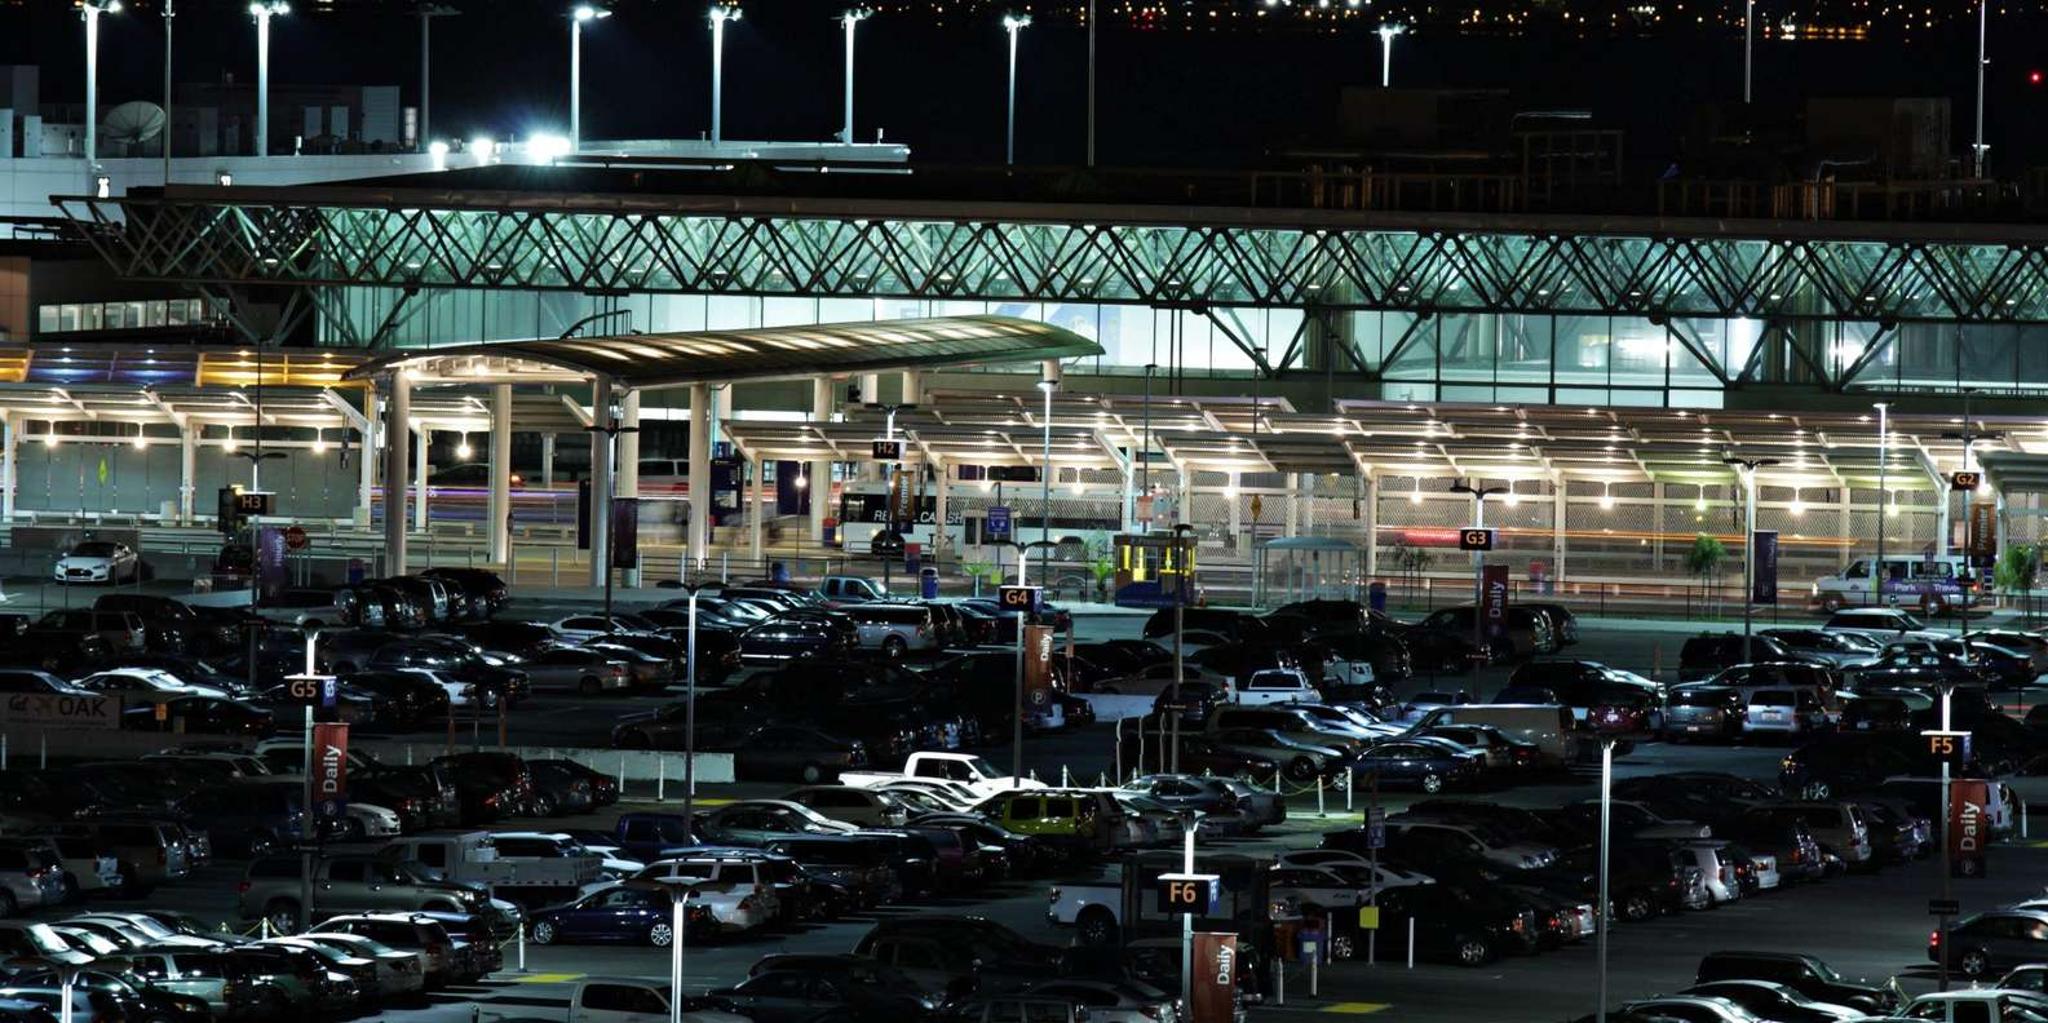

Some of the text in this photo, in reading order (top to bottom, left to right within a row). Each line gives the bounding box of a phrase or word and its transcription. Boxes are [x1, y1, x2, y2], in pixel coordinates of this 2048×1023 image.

[877, 442, 895, 455] H2
[1956, 473, 1975, 485] G2
[242, 496, 261, 508] H3
[899, 475, 908, 517] Premier
[1465, 530, 1487, 545] G3
[1977, 508, 1988, 550] Premier
[1005, 589, 1028, 605] G4
[1489, 581, 1505, 618] Daily
[1040, 633, 1053, 662] Daily
[291, 681, 317, 698] G5
[60, 697, 106, 716] OAK
[1931, 736, 1953, 754] F5
[323, 744, 342, 793] Daily
[1960, 800, 1981, 851] Daily
[1169, 881, 1197, 903] F6
[1217, 944, 1235, 985] Daily
